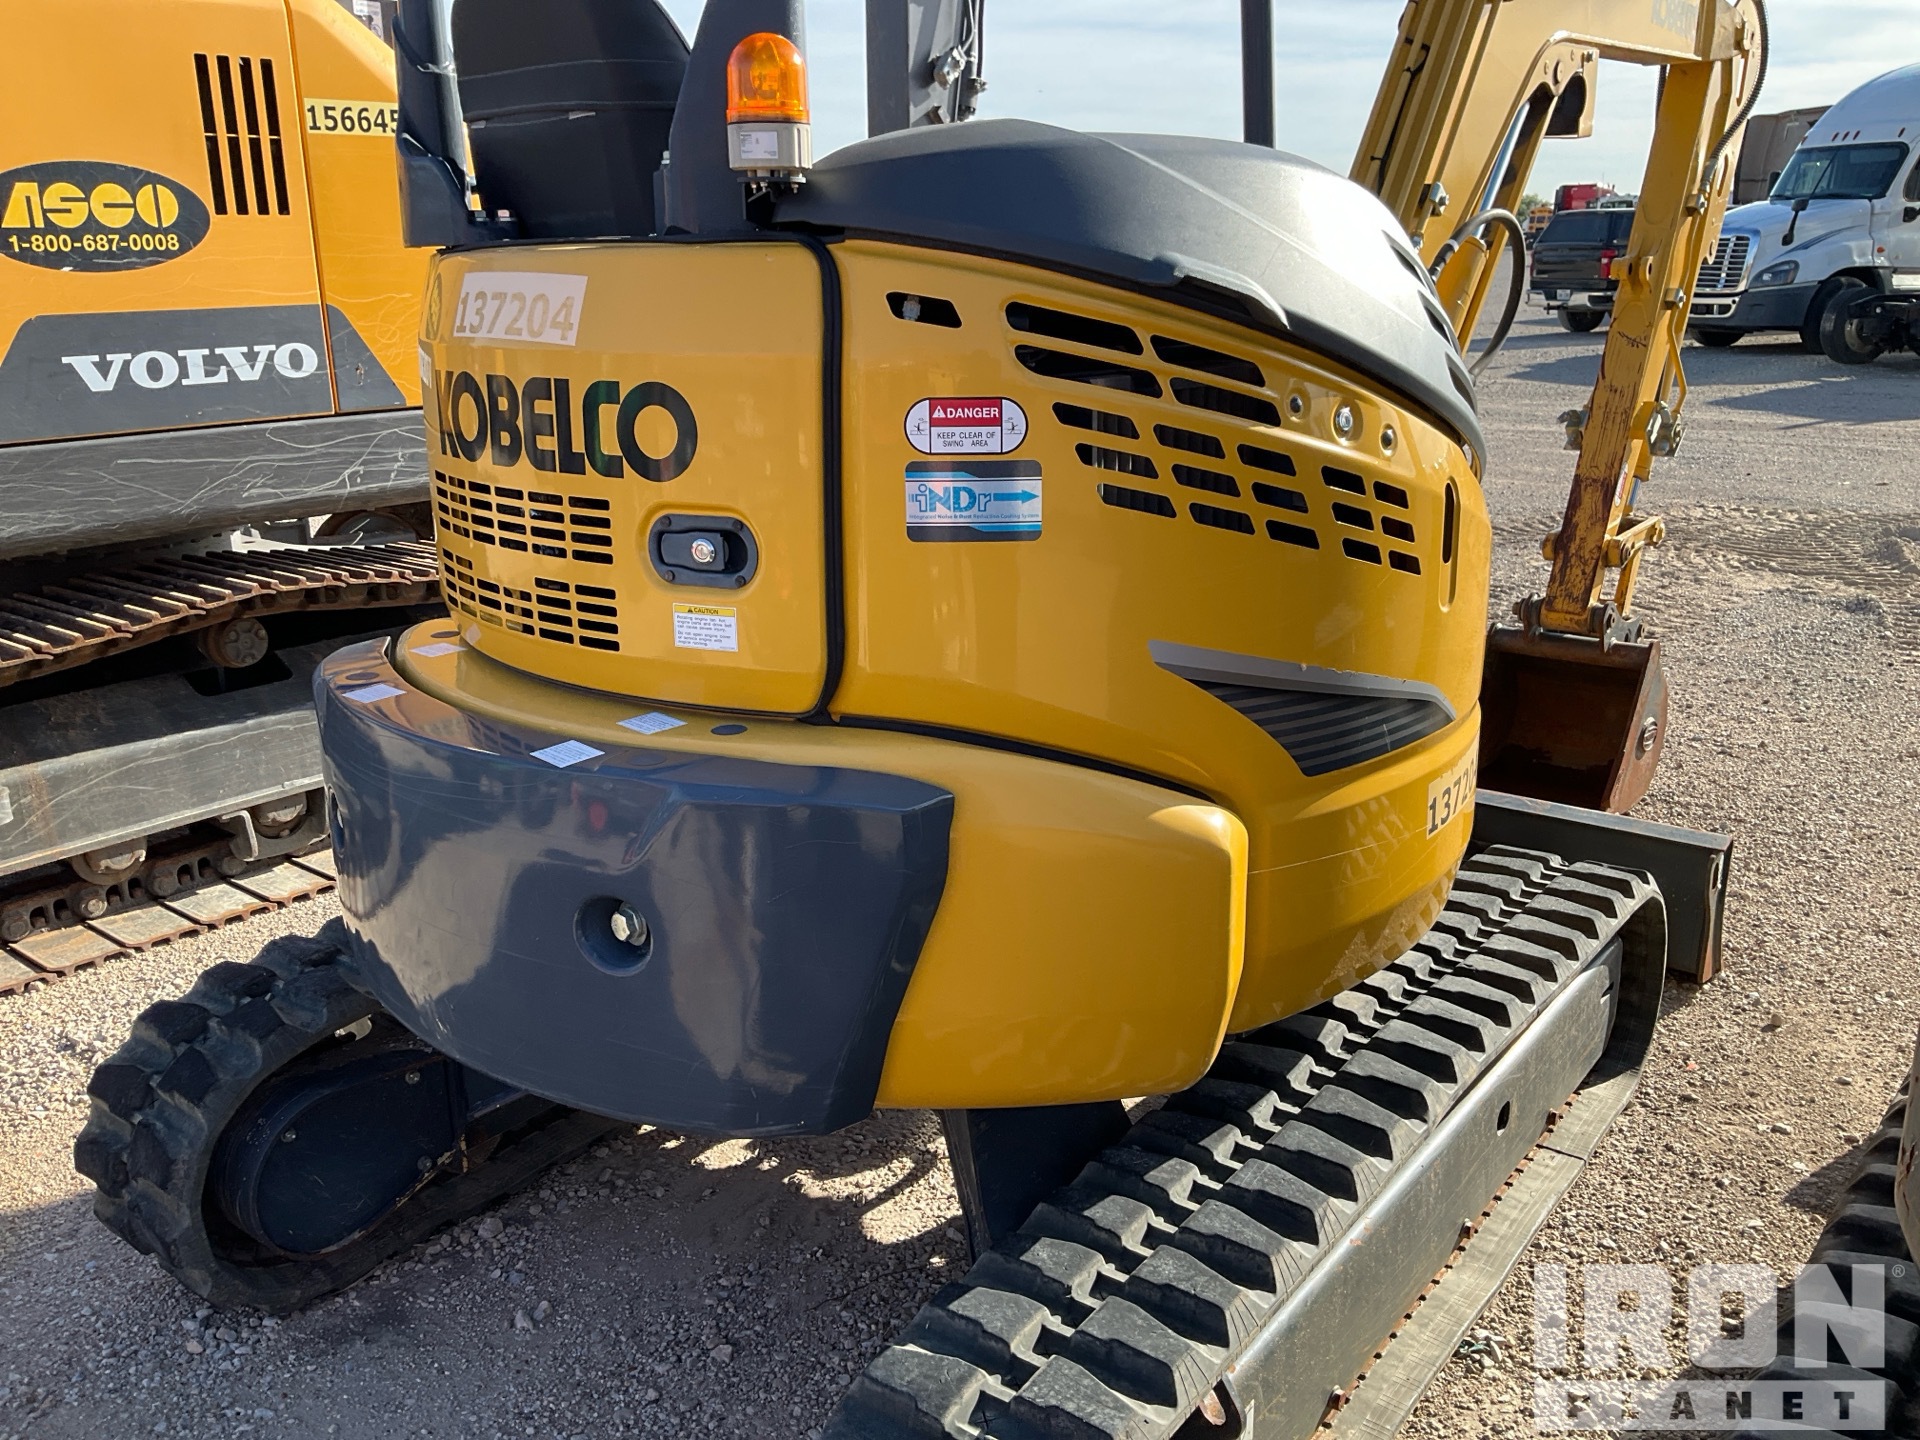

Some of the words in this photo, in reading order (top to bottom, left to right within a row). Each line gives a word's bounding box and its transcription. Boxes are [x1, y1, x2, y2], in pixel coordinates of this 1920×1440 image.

[1, 182, 179, 228] ASCO
[8, 234, 180, 252] 1-800-687-0008
[456, 290, 575, 341] 137204
[61, 342, 318, 392] VOLVO
[434, 370, 698, 483] KOBELCO
[946, 407, 999, 418] DANGER
[693, 607, 719, 615] CAUTION
